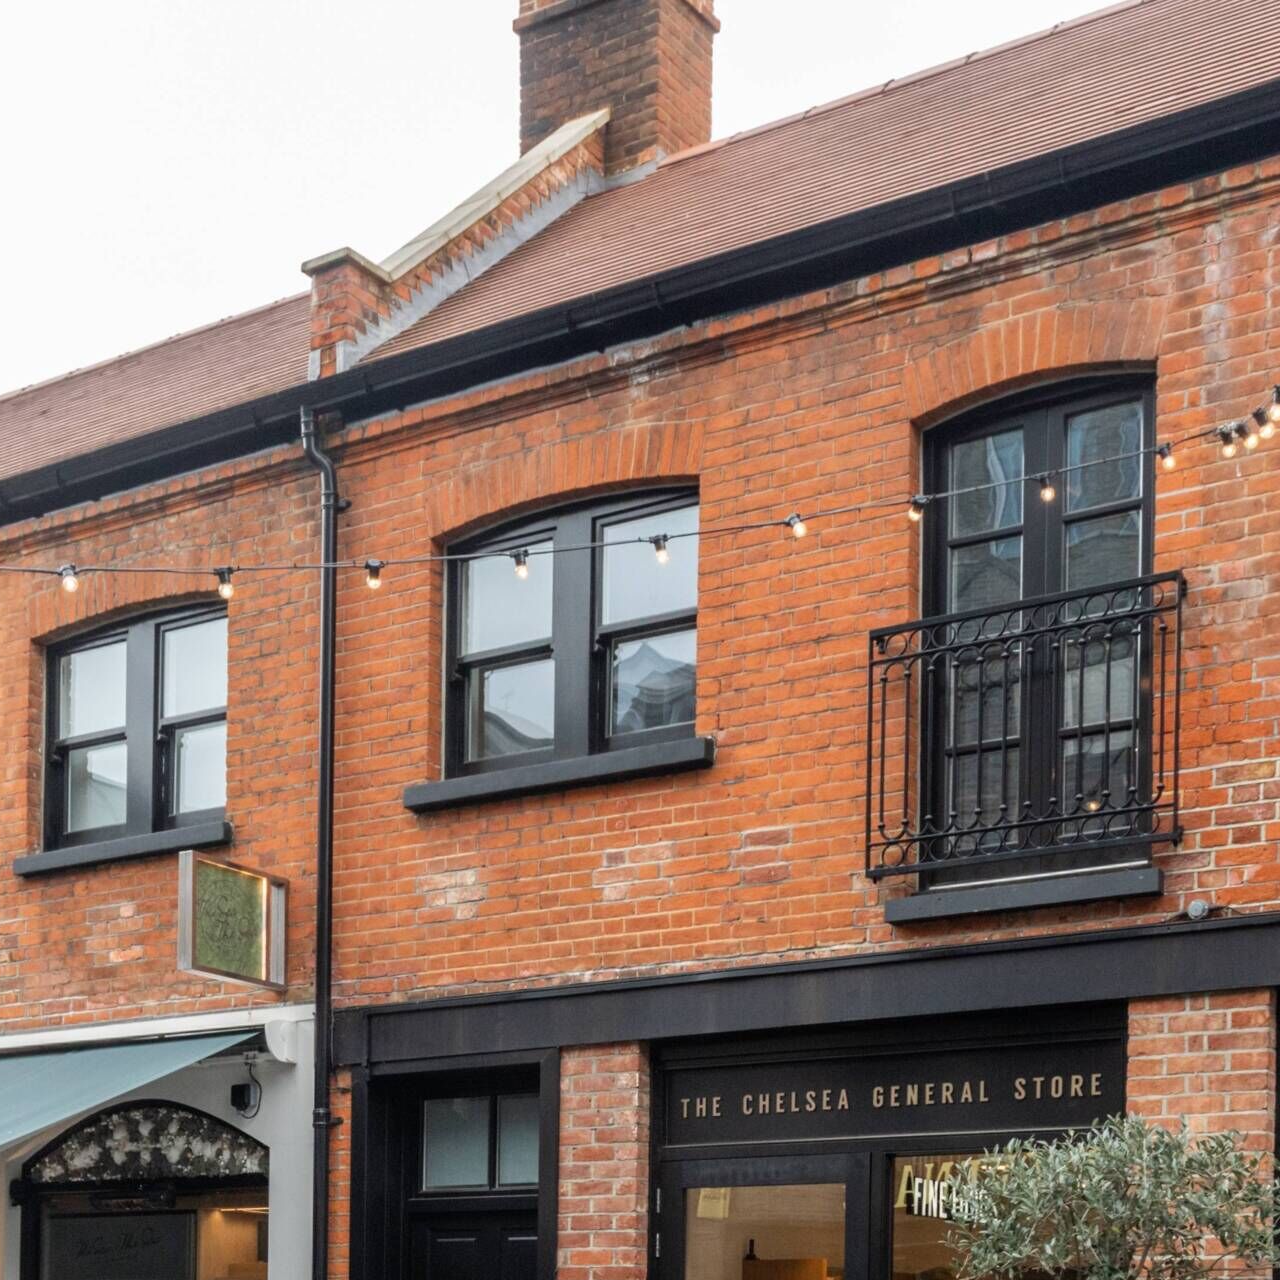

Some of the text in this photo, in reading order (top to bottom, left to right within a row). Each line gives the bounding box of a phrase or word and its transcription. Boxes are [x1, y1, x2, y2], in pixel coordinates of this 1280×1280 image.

[681, 1072, 1103, 1118] THE CHELSEA GENERAL STORE
[913, 1177, 948, 1219] FINE
